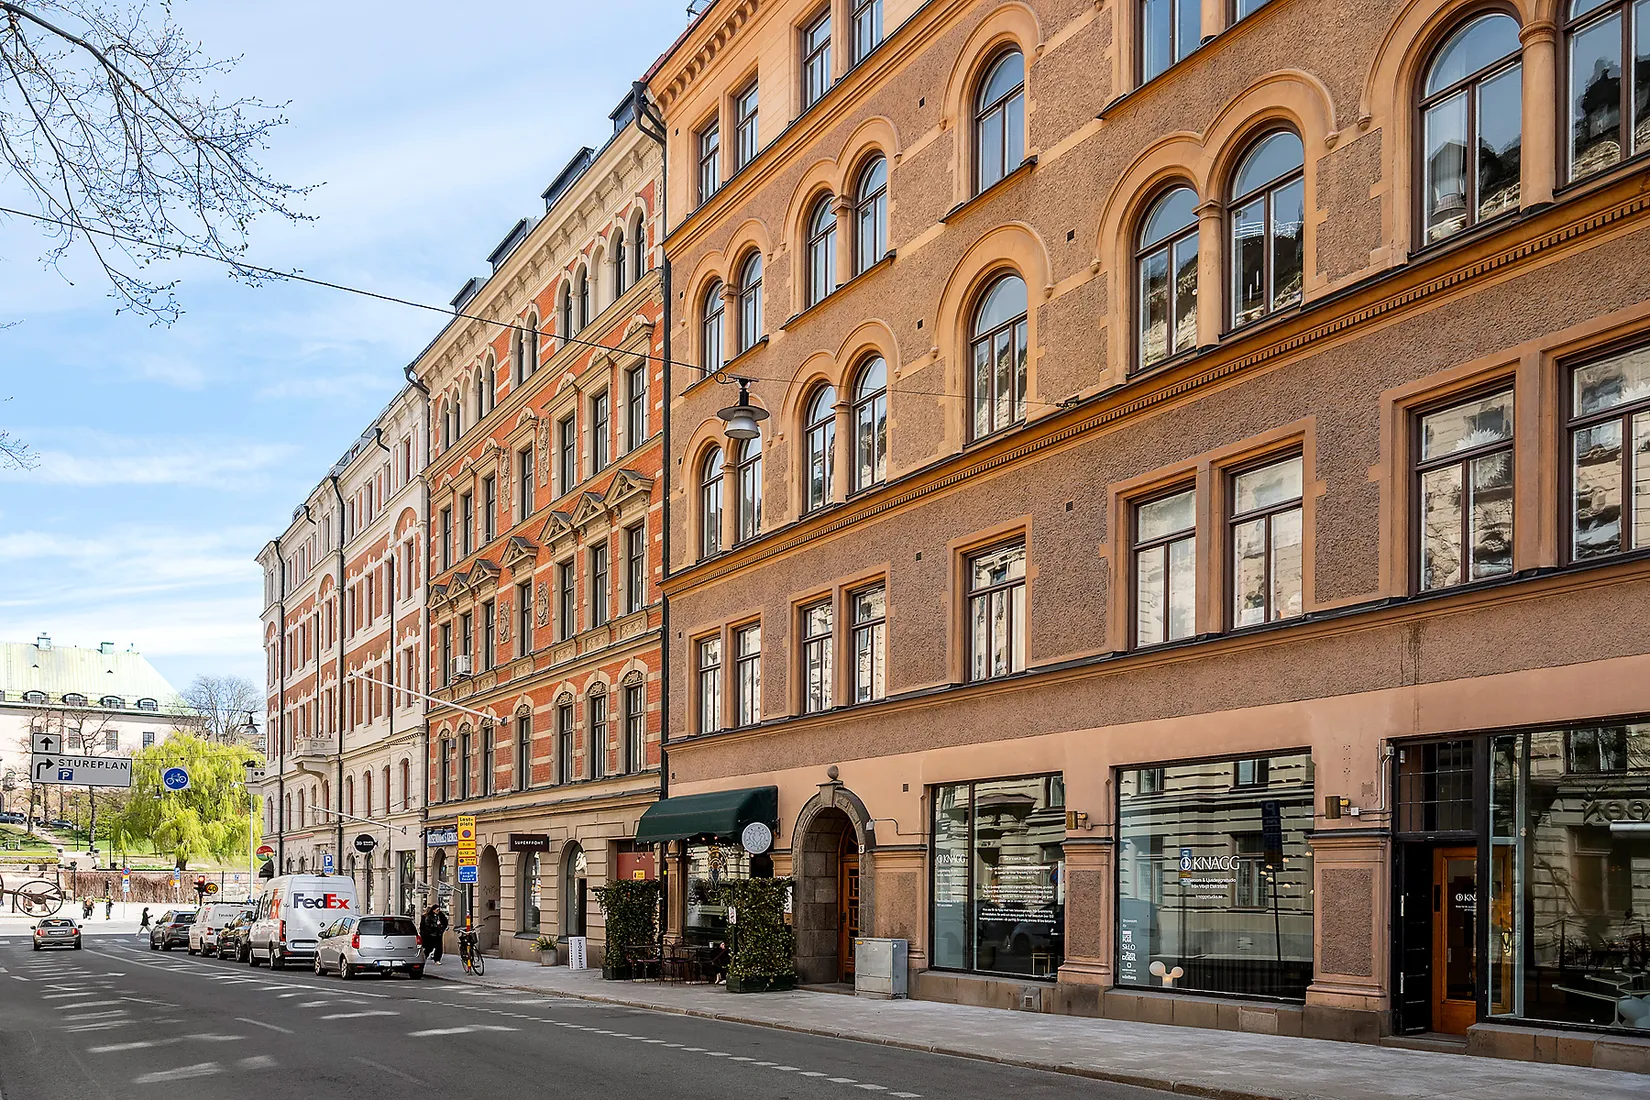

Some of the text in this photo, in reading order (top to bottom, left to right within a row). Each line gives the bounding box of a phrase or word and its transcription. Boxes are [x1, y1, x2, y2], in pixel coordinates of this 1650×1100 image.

[58, 759, 128, 770] STUREPLAN
[325, 856, 332, 866] P
[1193, 855, 1240, 870] KNAGG
[293, 893, 350, 910] FedEx
